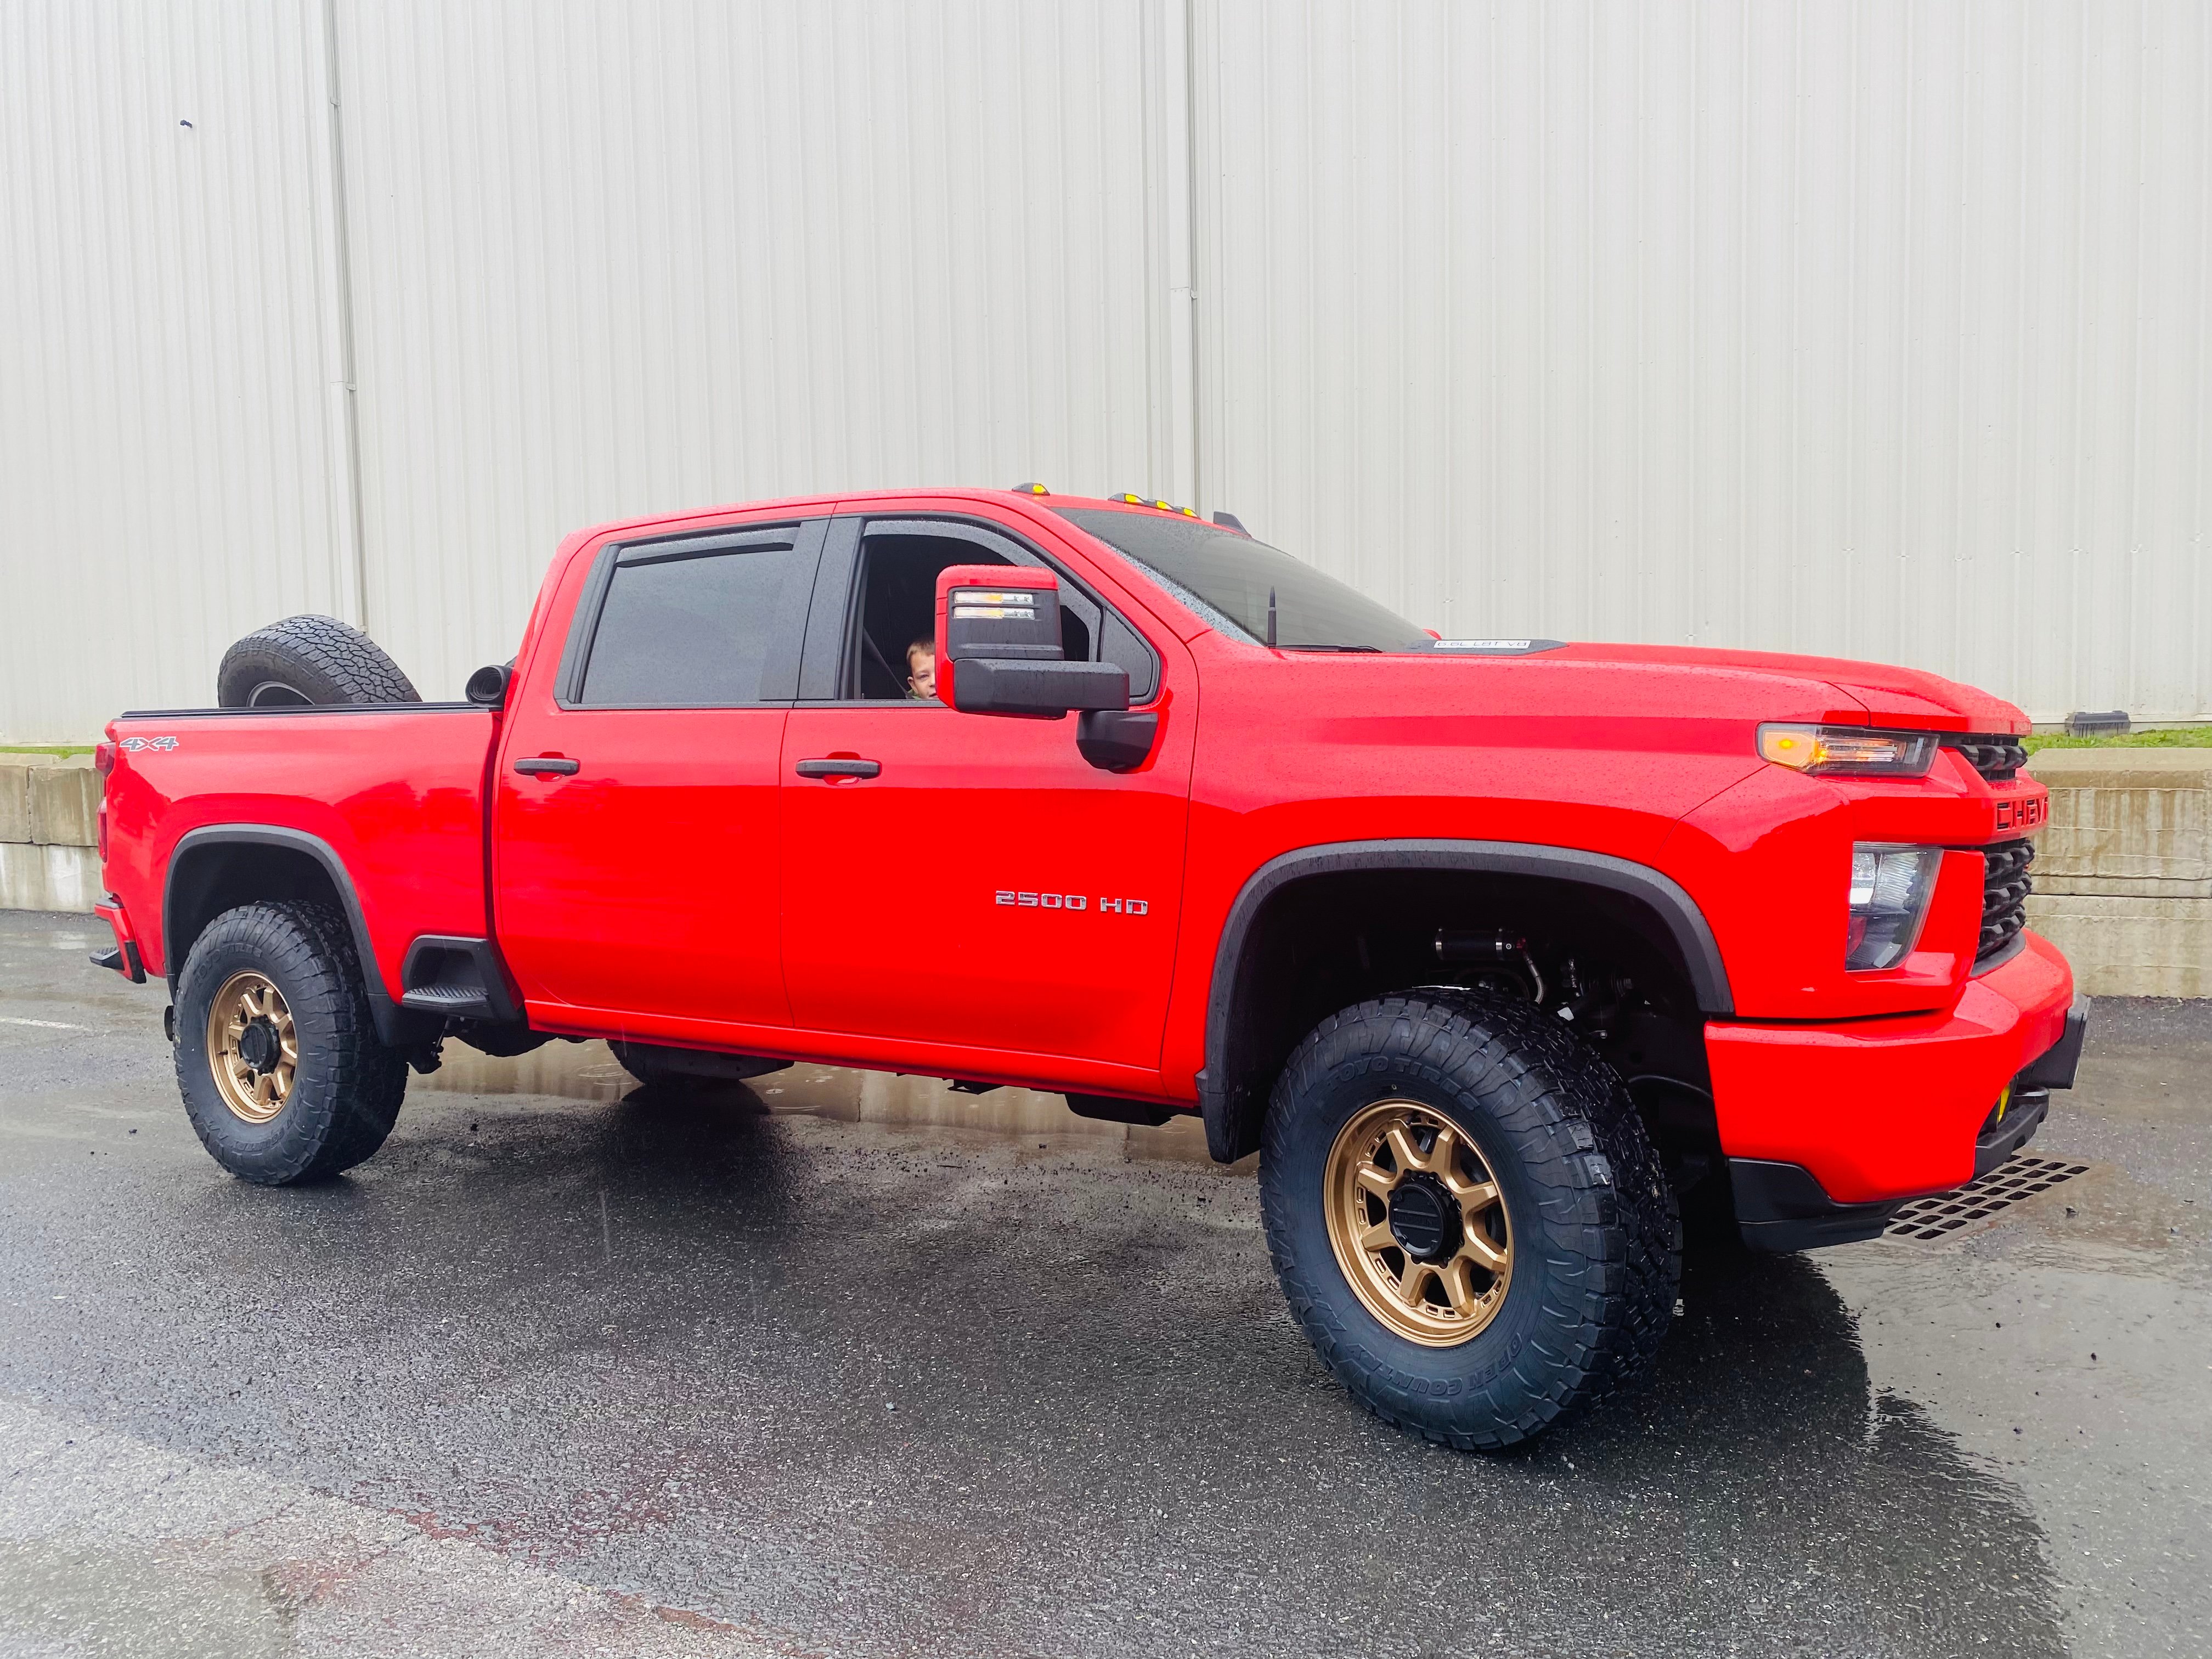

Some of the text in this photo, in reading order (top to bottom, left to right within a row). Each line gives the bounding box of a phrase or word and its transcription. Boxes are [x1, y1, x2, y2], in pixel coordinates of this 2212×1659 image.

[995, 890, 1148, 915] 2500 HD
[1325, 1056, 1481, 1111] TOYO TIRES
[1346, 1342, 1463, 1396] COUNTRY
[1468, 1332, 1522, 1391] OPEN
